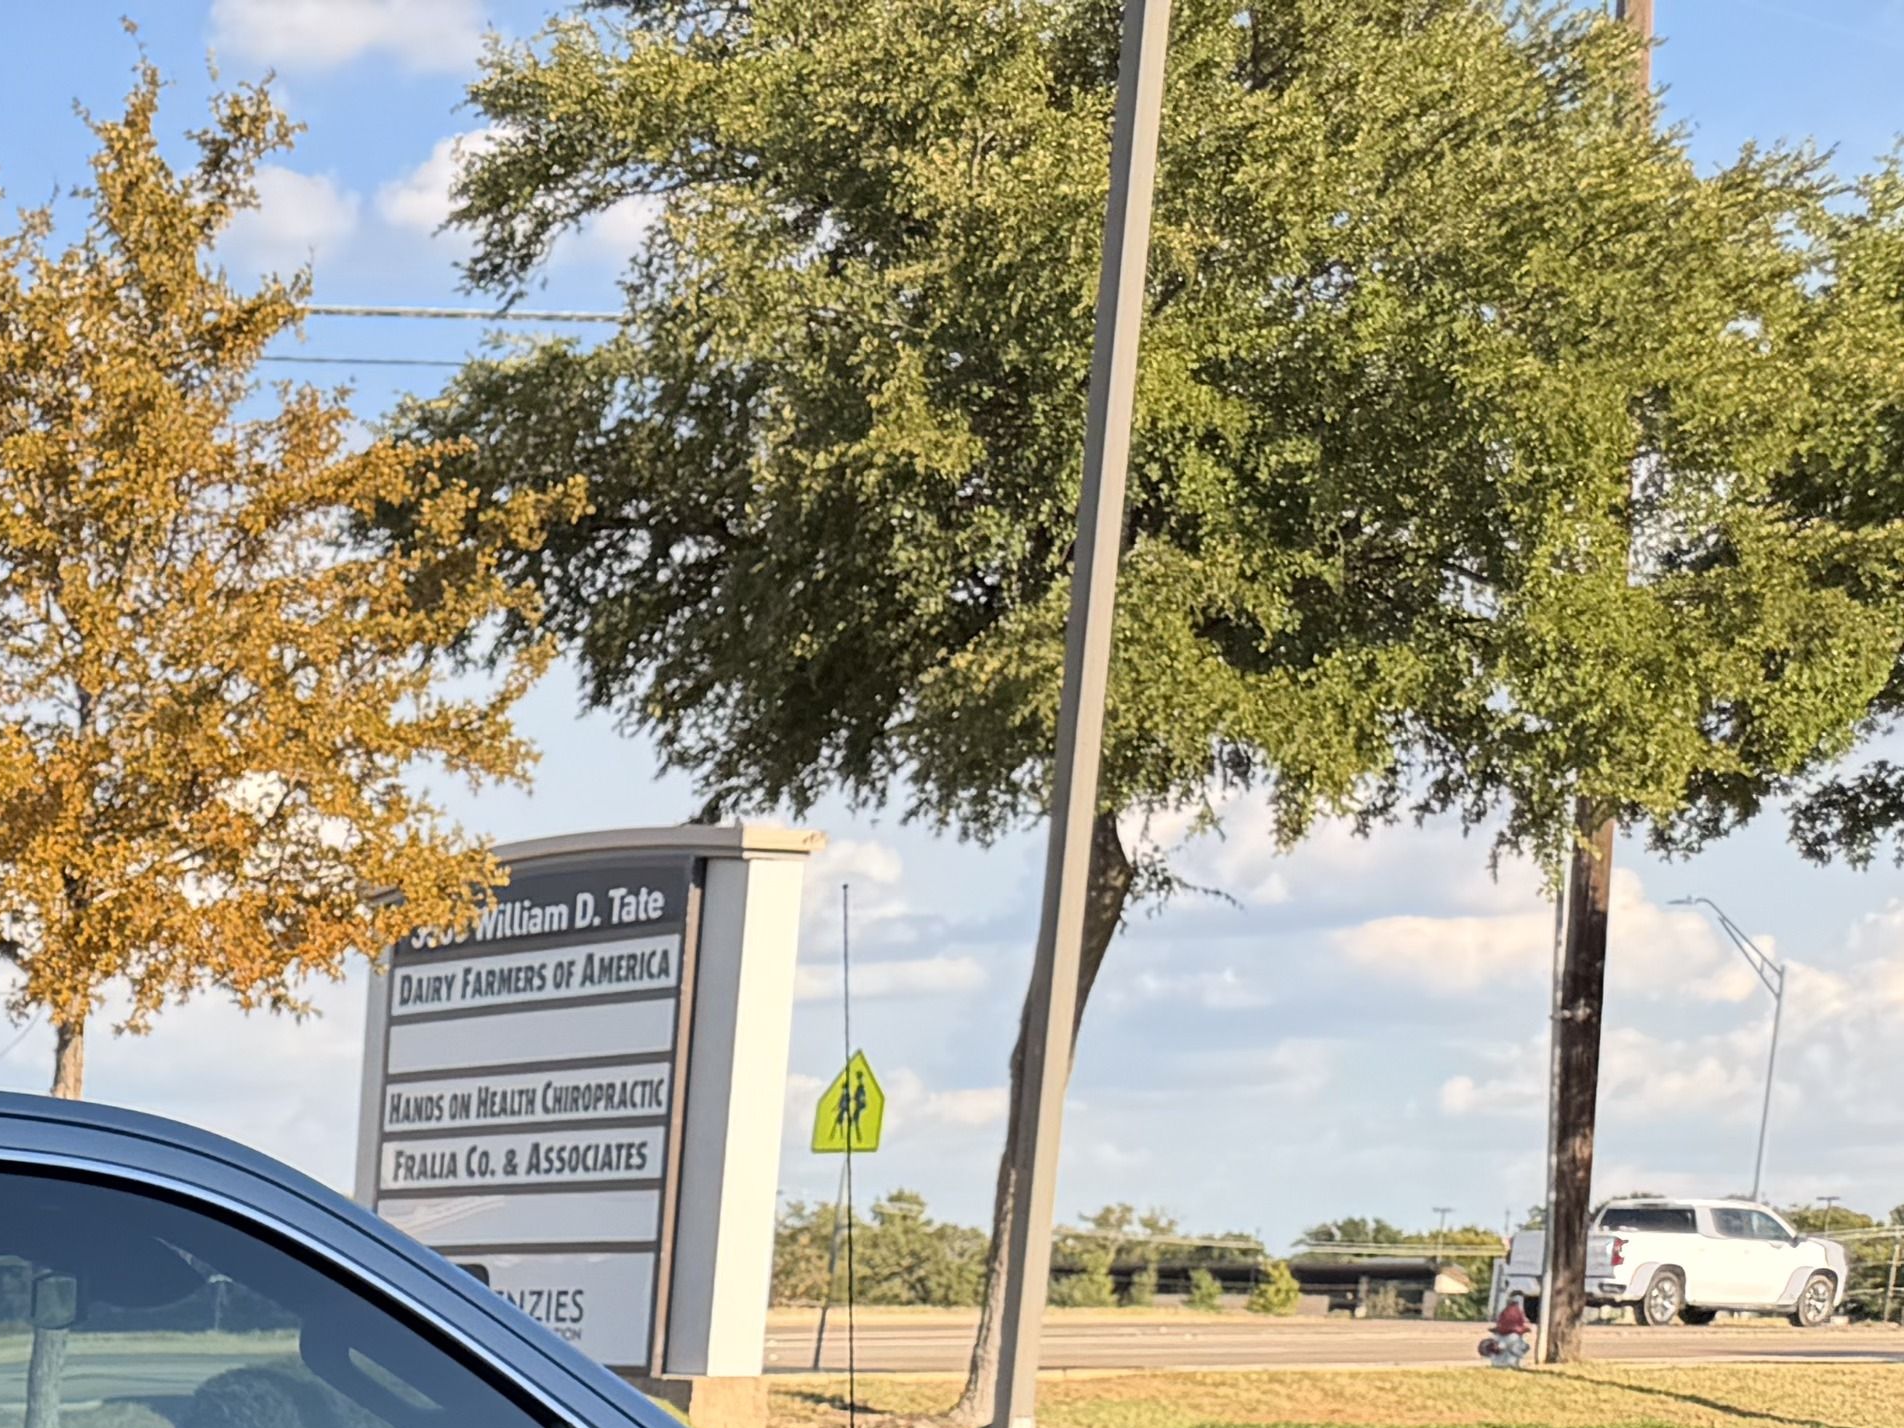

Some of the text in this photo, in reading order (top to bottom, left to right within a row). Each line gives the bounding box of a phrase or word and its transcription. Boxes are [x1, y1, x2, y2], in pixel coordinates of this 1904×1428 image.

[475, 899, 569, 941] William
[575, 892, 601, 930] D.
[608, 887, 666, 924] Tate
[399, 949, 671, 1006] DAIRY FARMERS OF AMERICA
[389, 1078, 666, 1125] HANDS ON HEALTH CHIROPRACTIC
[392, 1150, 458, 1181] FRALIA
[503, 1148, 519, 1176] &
[526, 1142, 649, 1175] ASSOCIATES
